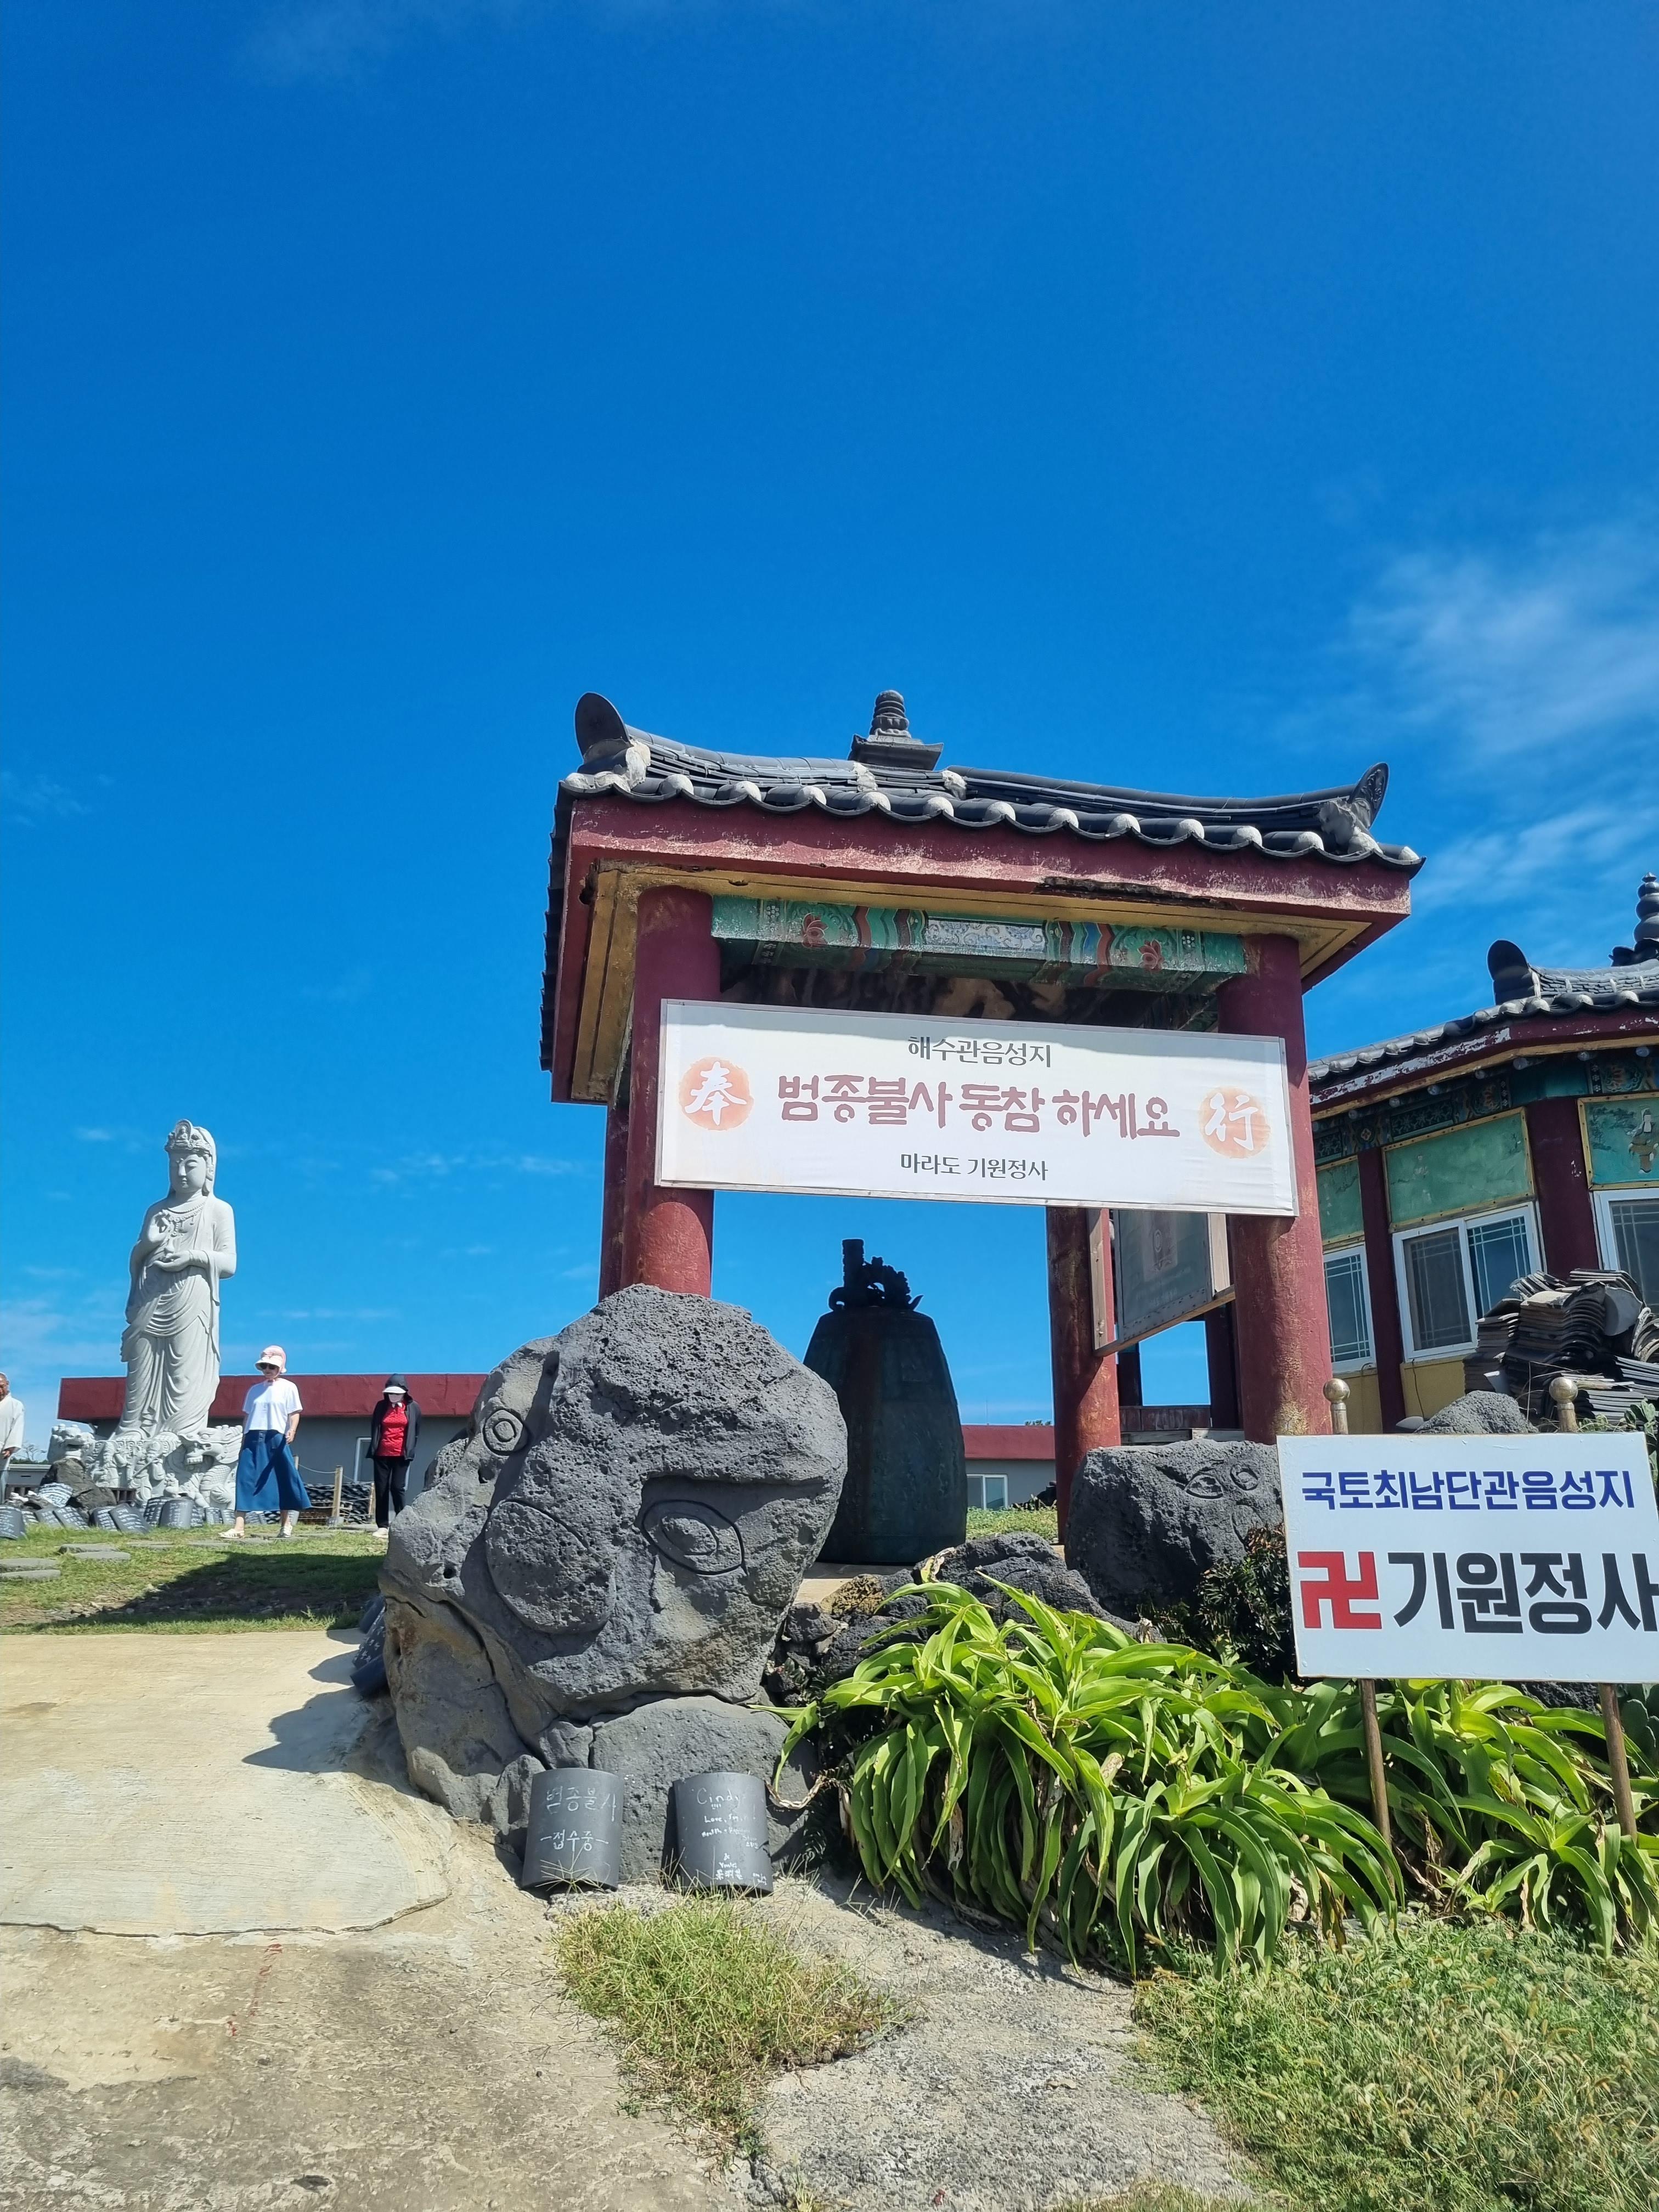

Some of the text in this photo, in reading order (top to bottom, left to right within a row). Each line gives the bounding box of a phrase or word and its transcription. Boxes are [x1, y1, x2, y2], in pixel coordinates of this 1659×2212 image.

[908, 1036, 1051, 1068] 해수관음성지
[778, 1074, 953, 1129] 범종불사
[1205, 1092, 1259, 1151] 行
[901, 1153, 1048, 1181] 마라도 기원정사
[1301, 1470, 1635, 1510] 국토최남단관음성지
[1387, 1552, 1659, 1635] 기원정사
